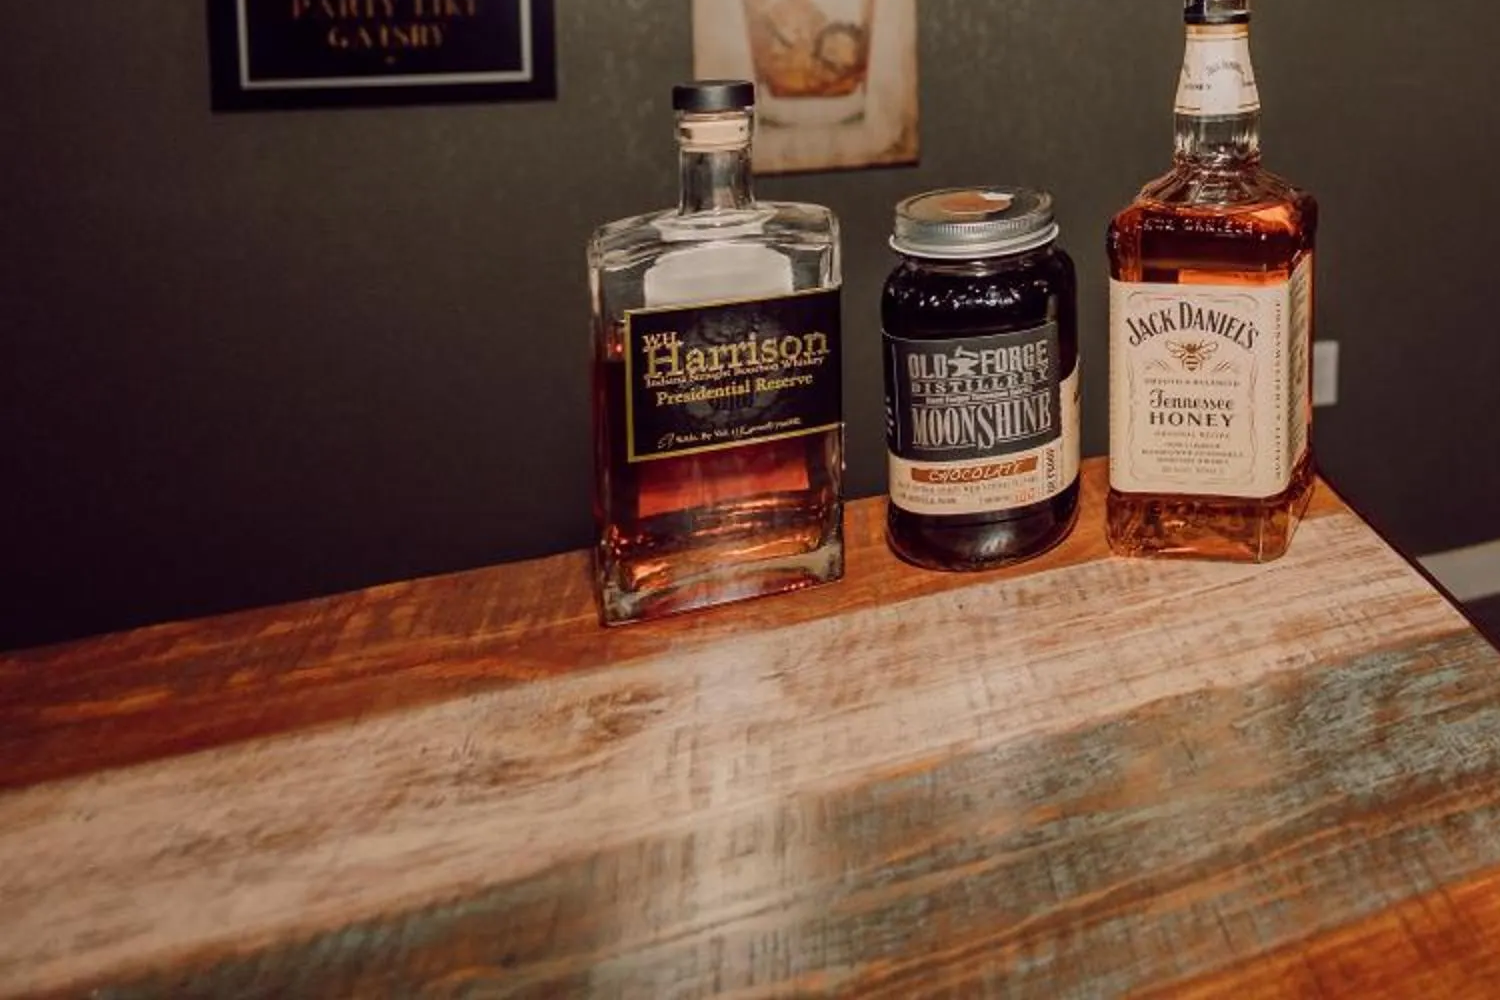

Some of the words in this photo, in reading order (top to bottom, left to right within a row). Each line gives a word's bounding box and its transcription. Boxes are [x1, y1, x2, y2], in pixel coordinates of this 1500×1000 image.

[328, 23, 448, 49] GATSBY
[1126, 310, 1178, 347] JACK
[1179, 302, 1259, 349] DANIEL'S
[644, 332, 831, 378] Harrison
[908, 353, 948, 379] OLD
[981, 340, 1048, 375] FORGE
[656, 379, 750, 407] Presidential
[755, 373, 814, 393] Reserve
[911, 366, 1049, 393] DISTILLERY
[1150, 388, 1234, 410] Tennessee
[911, 390, 1052, 450] MOONSHINE
[1150, 411, 1234, 428] HONEY
